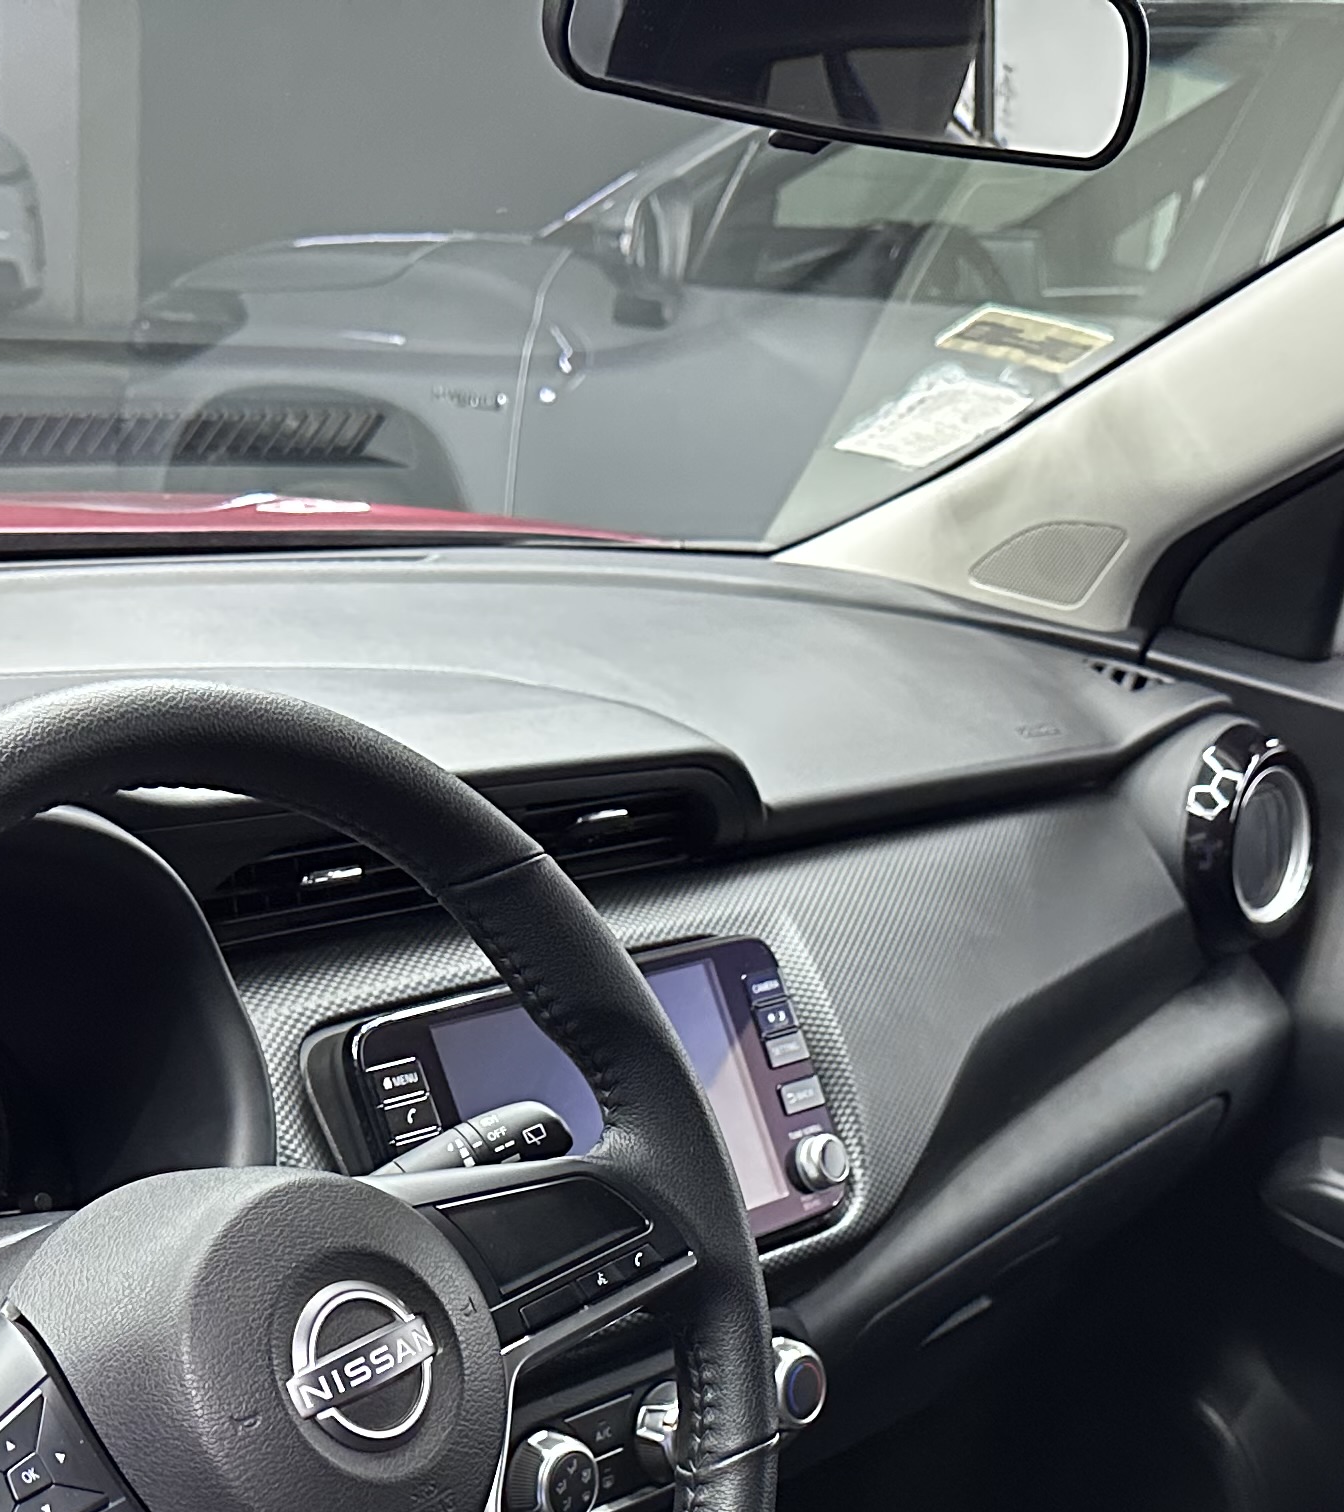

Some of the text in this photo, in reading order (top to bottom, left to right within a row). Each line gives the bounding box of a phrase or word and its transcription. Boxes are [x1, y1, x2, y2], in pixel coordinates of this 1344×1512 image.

[392, 1071, 419, 1088] MENU
[486, 1126, 508, 1142] OFF
[297, 1323, 435, 1410] NISSAN
[21, 1467, 40, 1484] OK
